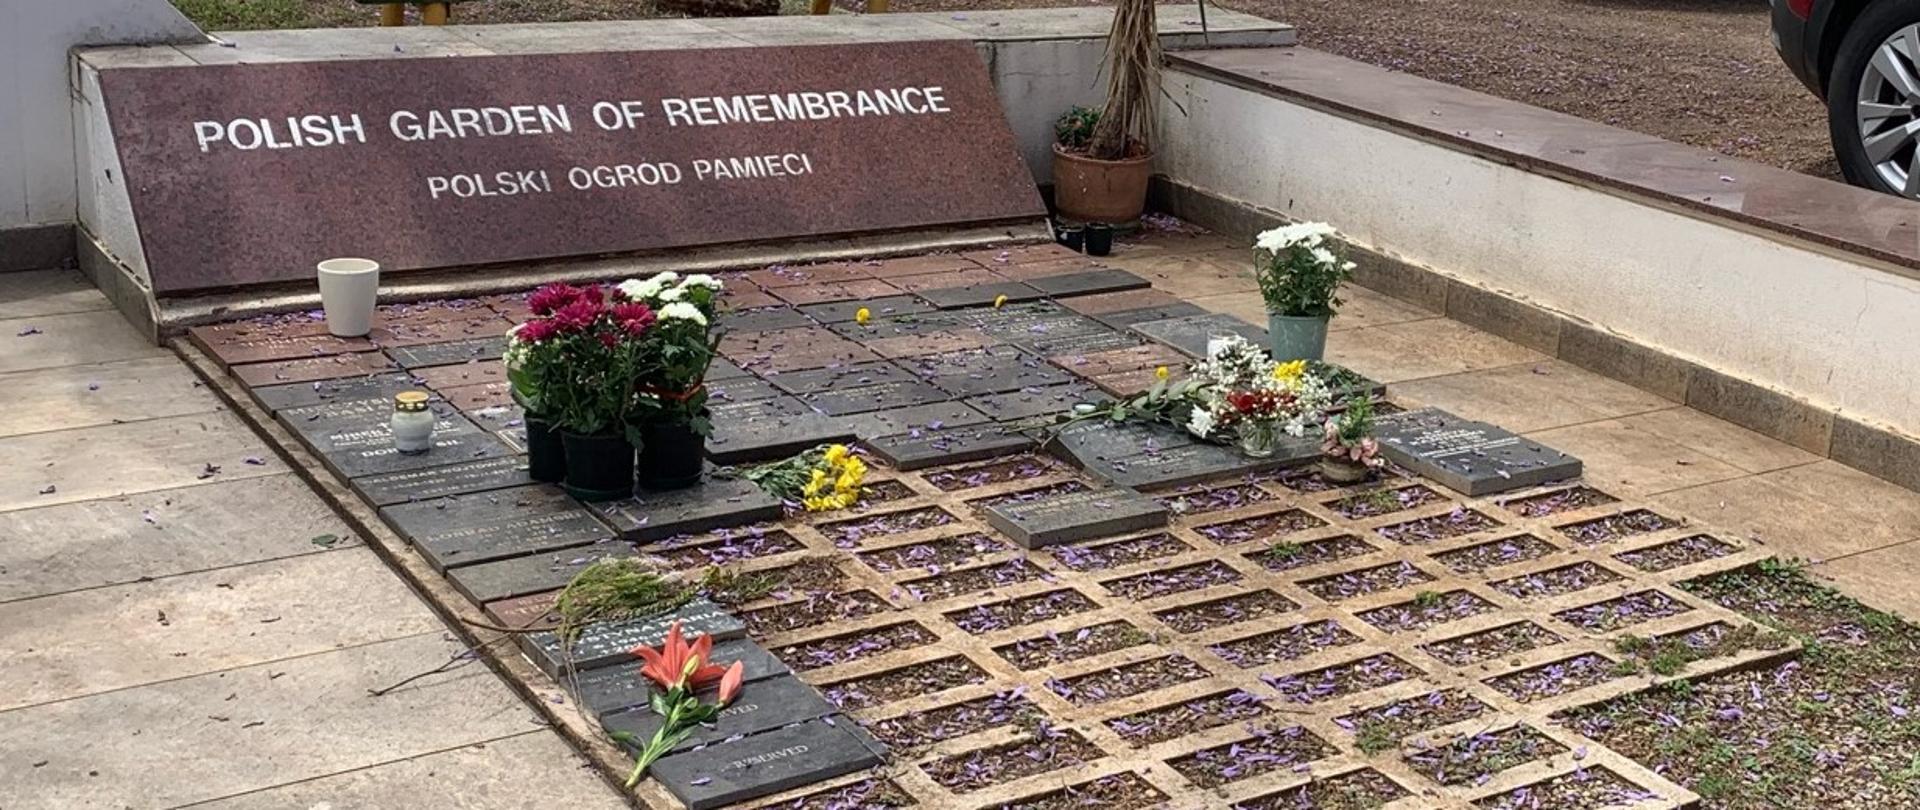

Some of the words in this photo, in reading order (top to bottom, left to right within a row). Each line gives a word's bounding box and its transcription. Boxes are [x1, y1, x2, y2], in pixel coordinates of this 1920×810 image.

[194, 113, 366, 152] POLISH
[389, 104, 573, 142] GARDEN
[592, 101, 645, 131] OF
[661, 87, 951, 127] REMEMBRANCE
[427, 169, 552, 199] POLSKI
[568, 162, 682, 191] OGROD
[693, 153, 813, 182] PAMIECI
